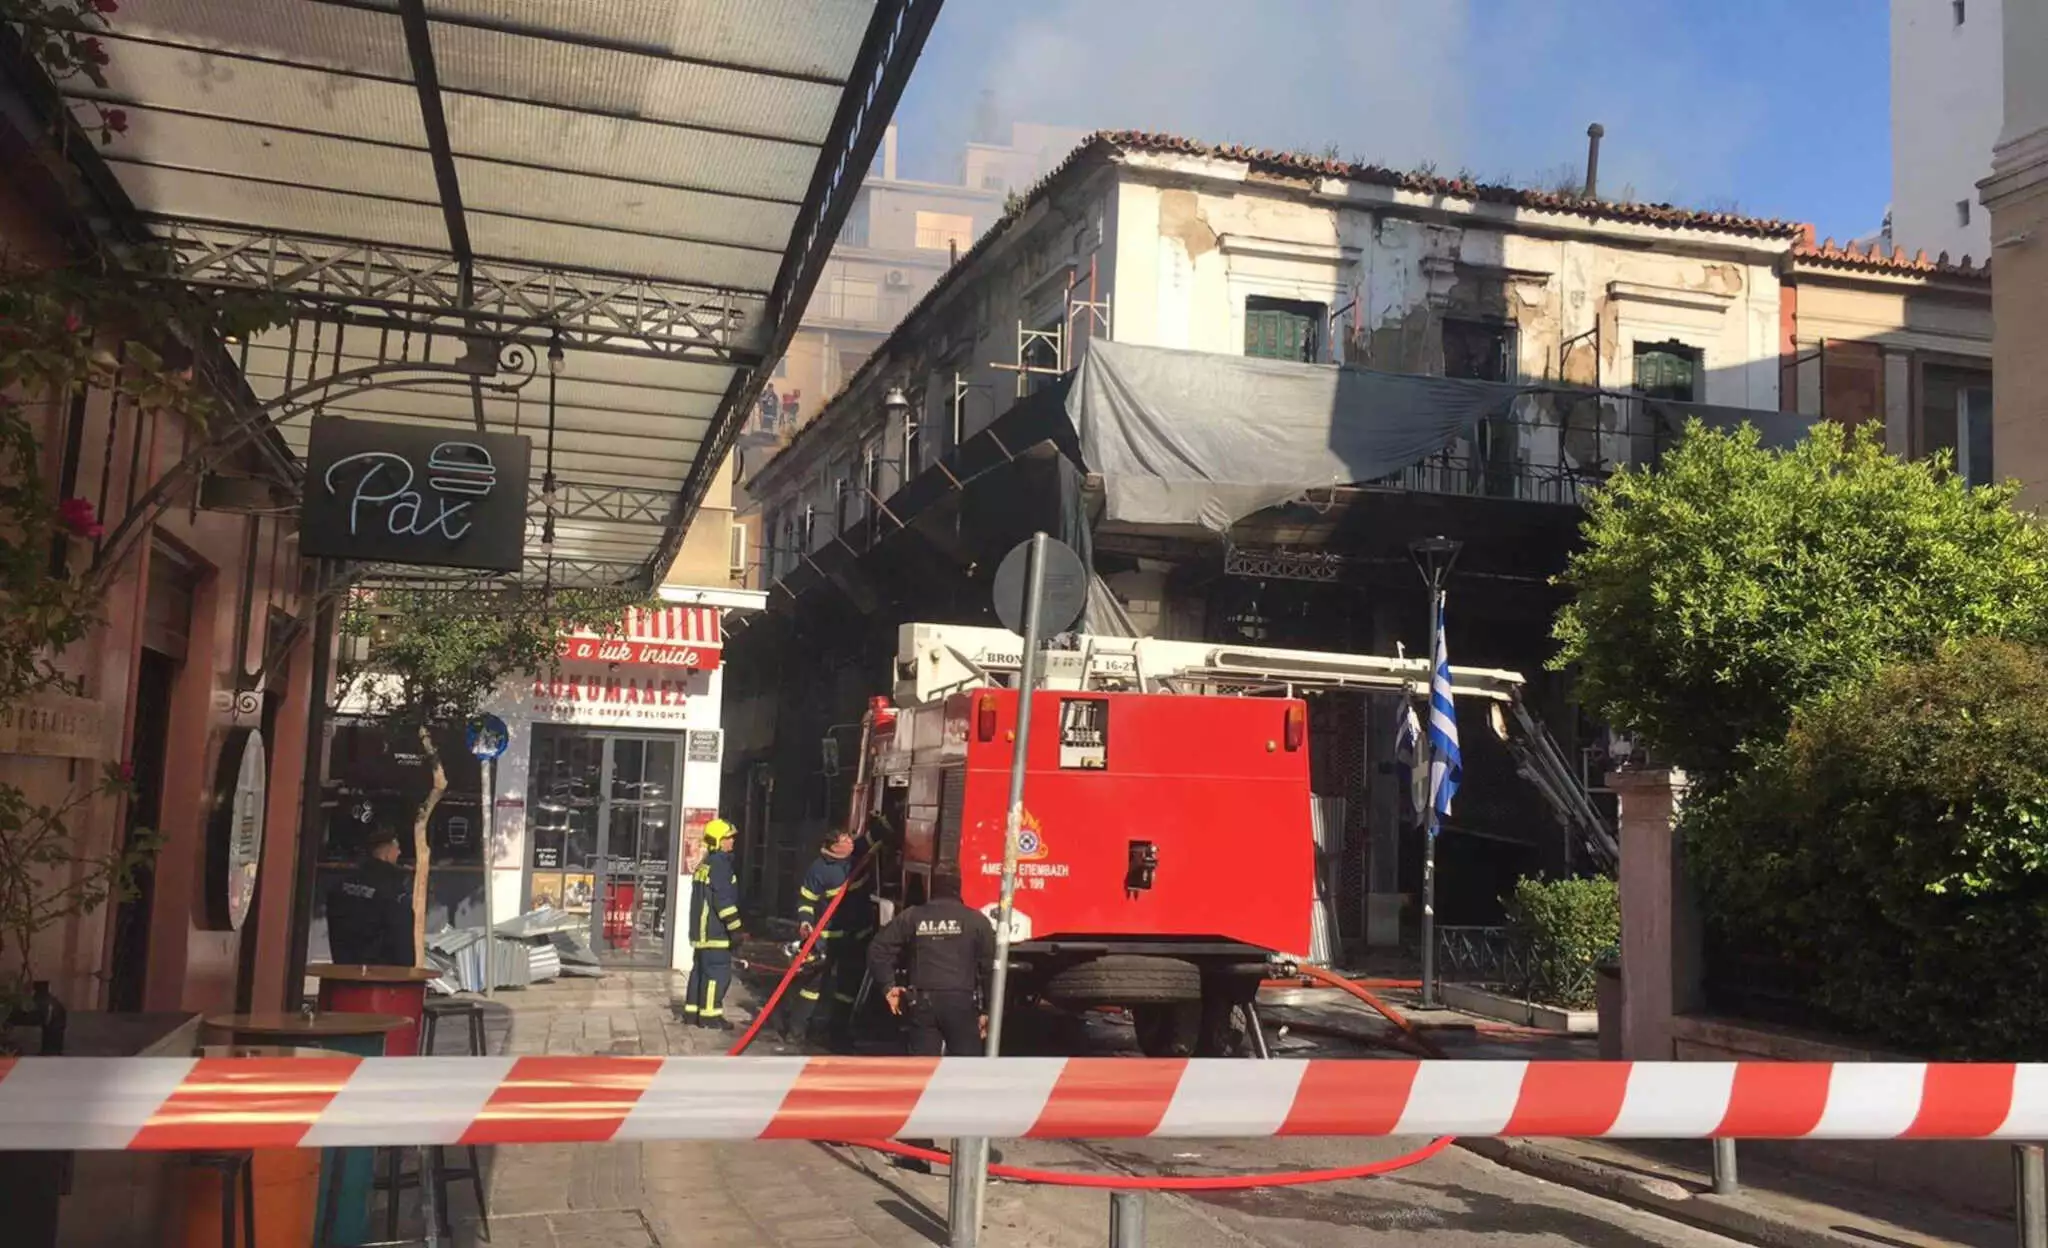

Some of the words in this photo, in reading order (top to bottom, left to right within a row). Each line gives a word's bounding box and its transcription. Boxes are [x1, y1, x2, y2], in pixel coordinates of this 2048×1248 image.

[325, 451, 472, 540] Pax
[577, 643, 593, 657] a
[639, 644, 699, 666] inside
[599, 709, 631, 718] GREEK
[637, 710, 687, 720] DELIGHTS
